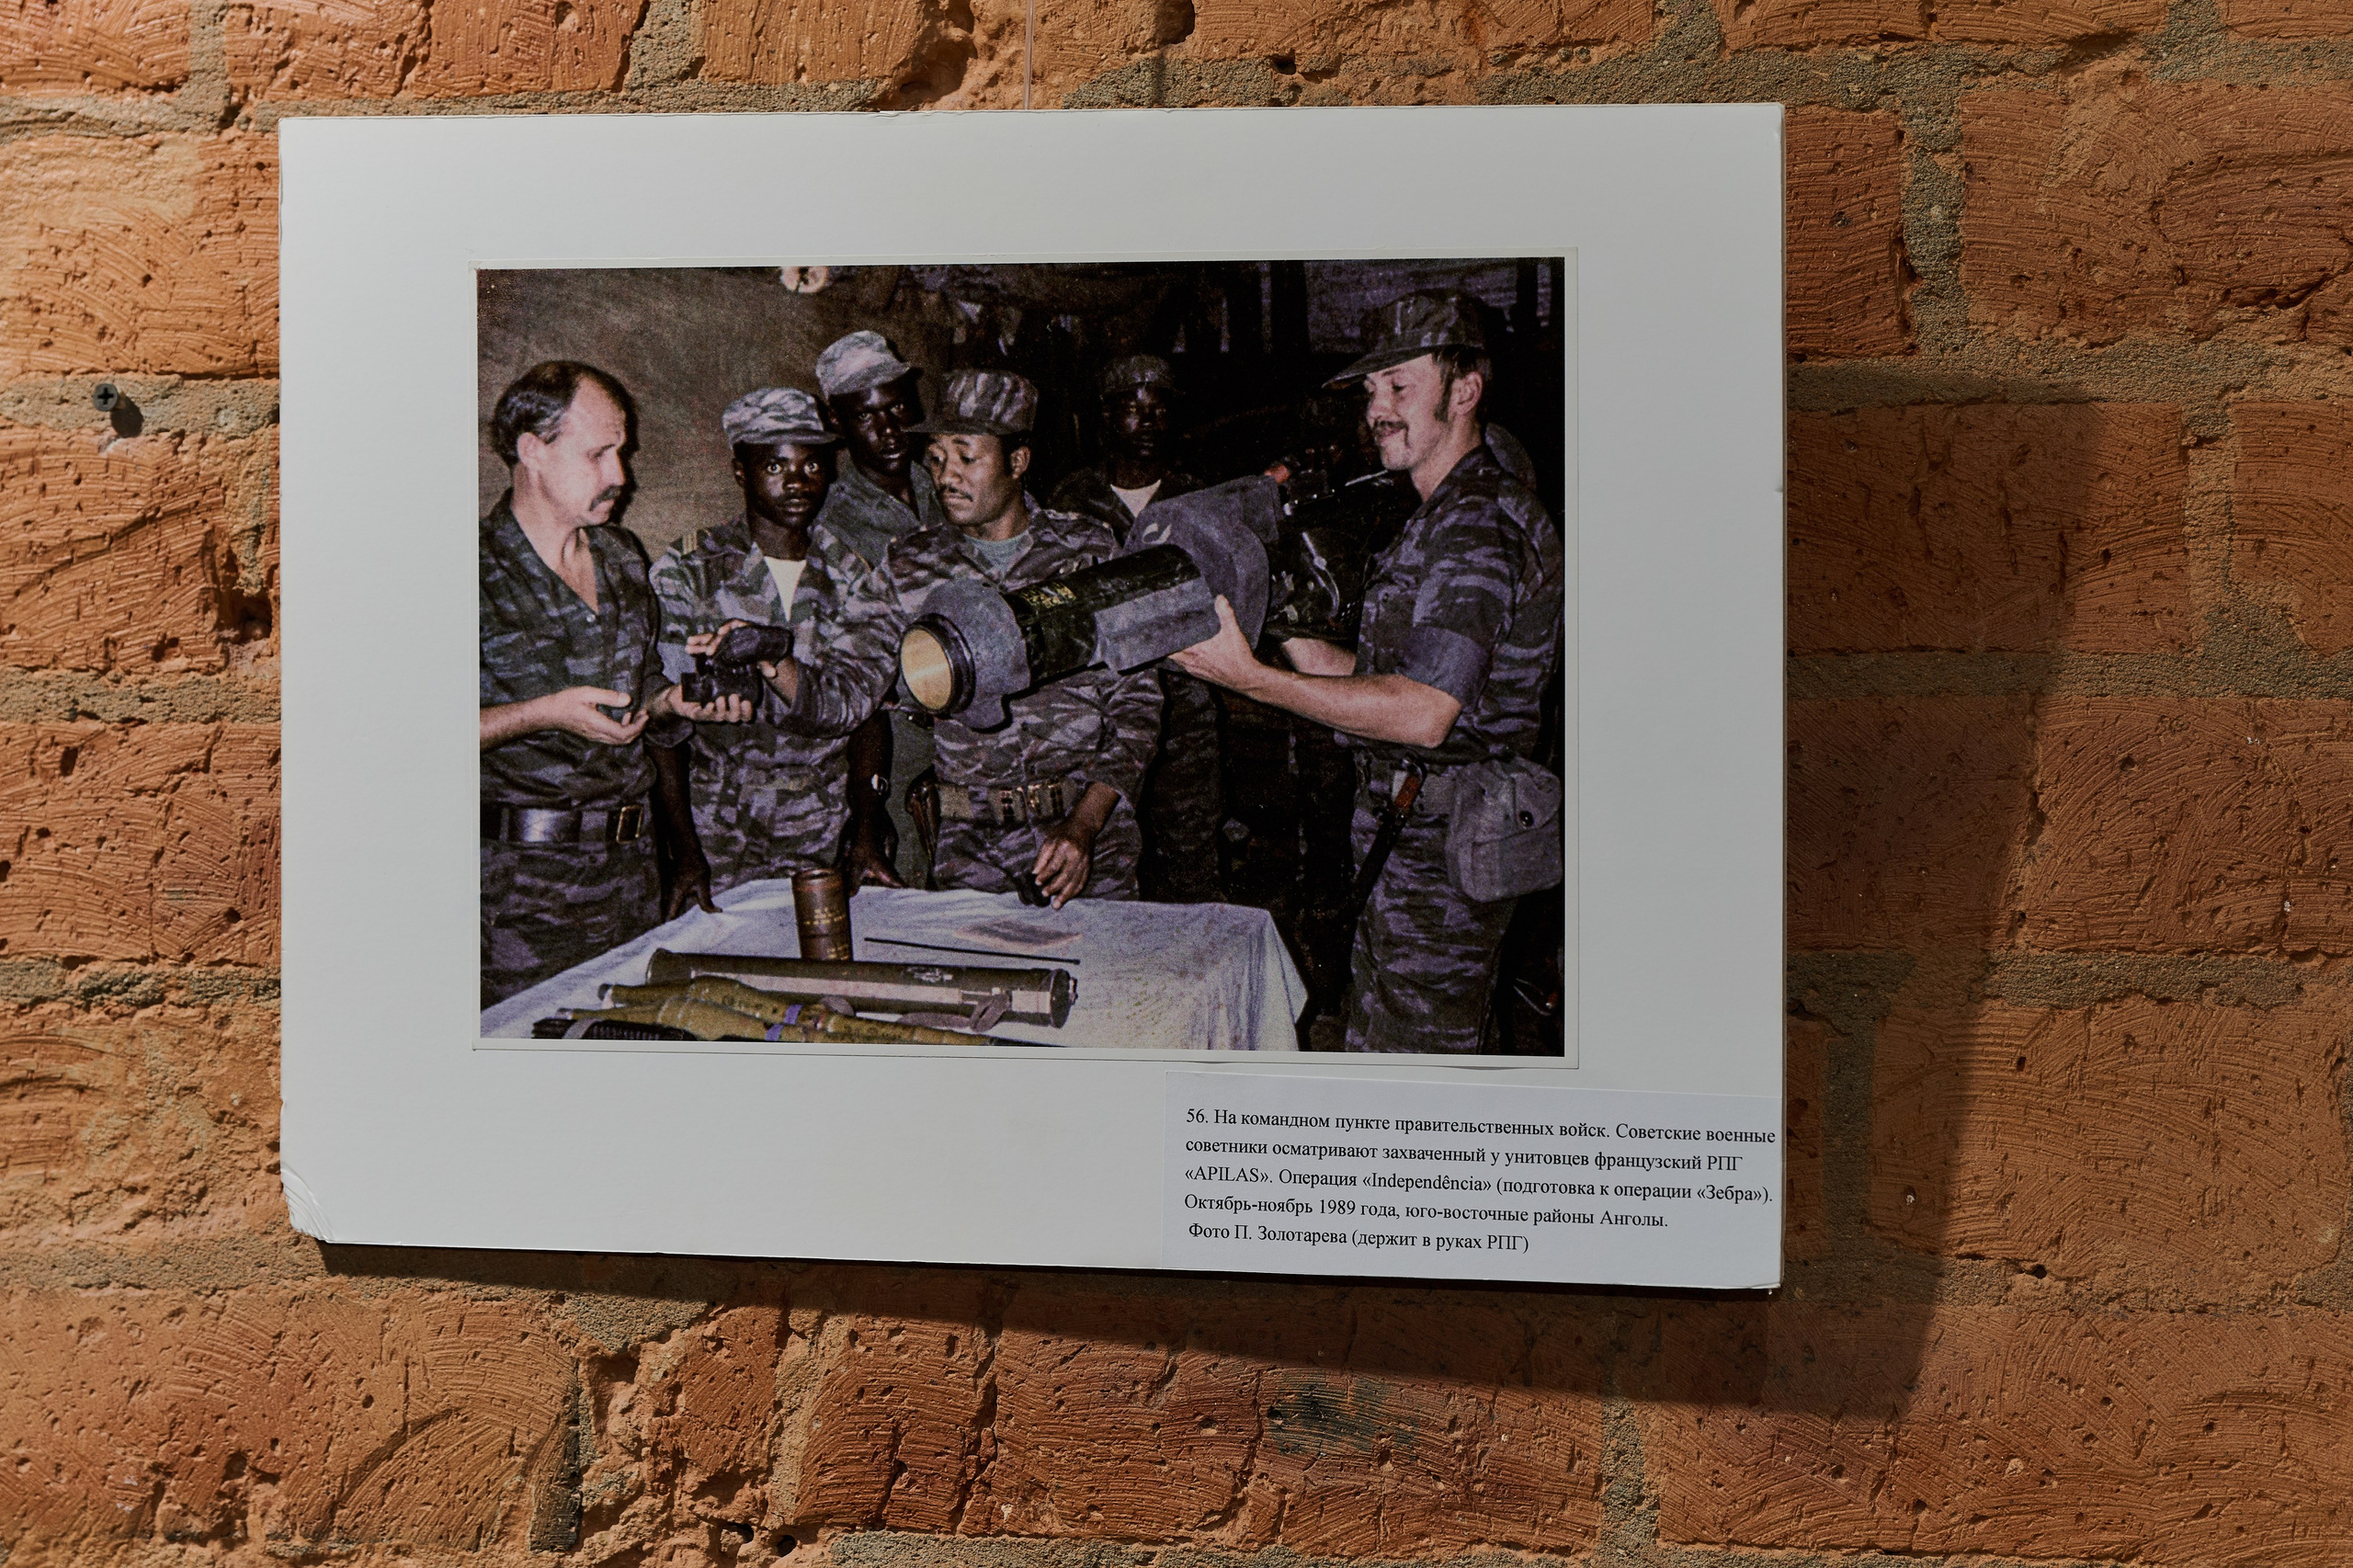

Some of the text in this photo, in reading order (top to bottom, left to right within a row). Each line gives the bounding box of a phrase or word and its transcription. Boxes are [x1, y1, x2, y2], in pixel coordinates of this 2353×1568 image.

[1186, 1108, 1776, 1144] 56. На командном пункте правительственных войск. Советские военные
[1185, 1140, 1744, 1173] советники осматривают захваченный у унитовцев французский РПГ
[1184, 1165, 1773, 1206] «APILAS». Операция «Independência» (подготовка к операции «Зебра»).
[1184, 1193, 1668, 1227] Октябрь-ноябрь 1989 года, юго-восточные районы Анголы.
[1188, 1222, 1529, 1255] Фото П. Золотарева (держит в руках РПГ)
